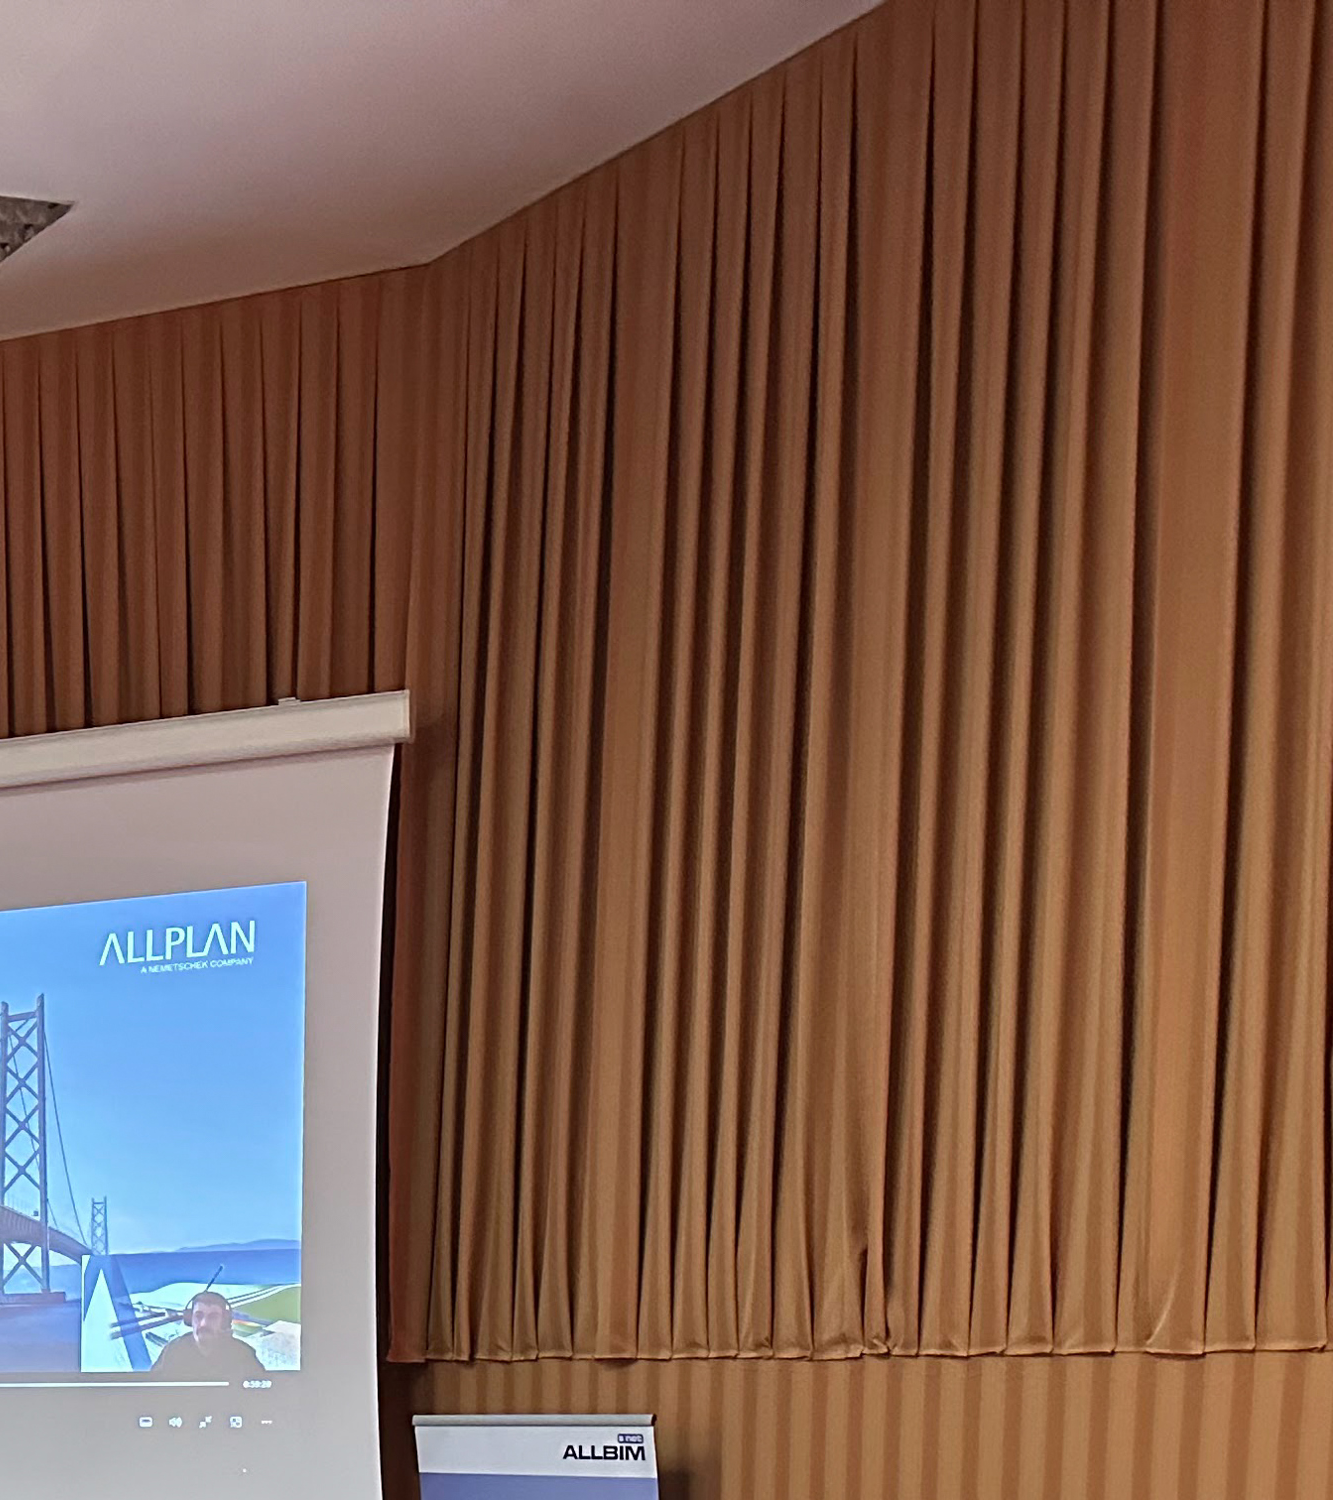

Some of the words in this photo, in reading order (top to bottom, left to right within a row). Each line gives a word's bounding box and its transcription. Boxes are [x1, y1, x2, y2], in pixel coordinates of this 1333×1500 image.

[99, 920, 255, 966] ALLPLAN
[210, 957, 254, 969] COMPANY
[563, 1445, 646, 1461] ALLBIM
